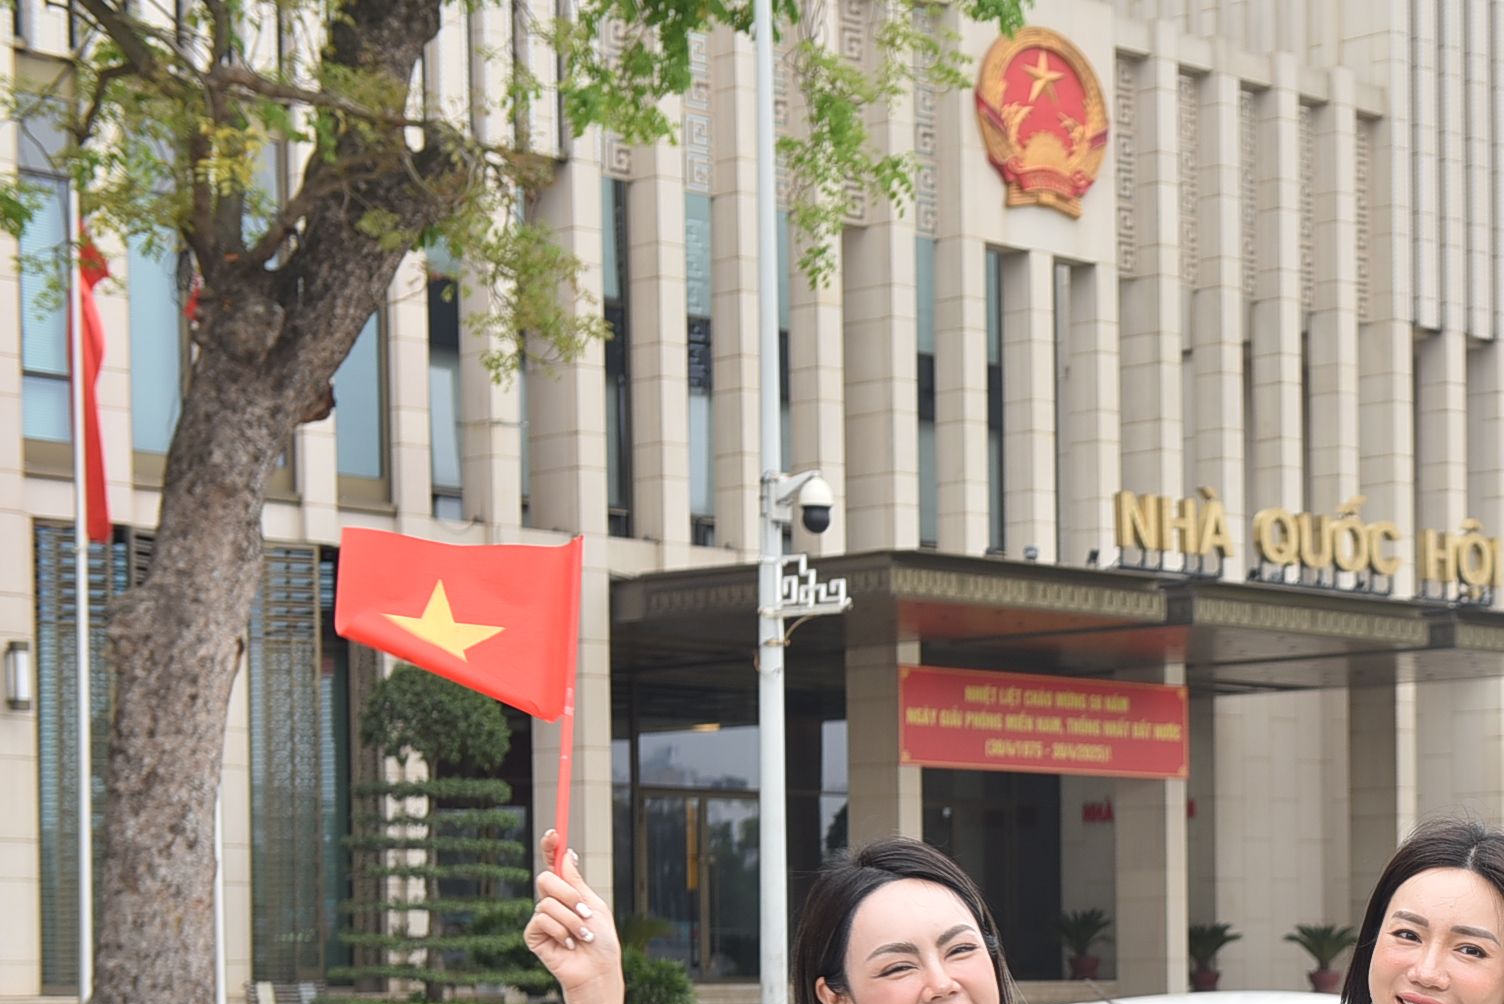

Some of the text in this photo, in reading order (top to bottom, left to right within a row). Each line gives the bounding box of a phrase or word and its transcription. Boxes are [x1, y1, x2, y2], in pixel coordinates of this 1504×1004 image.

[1114, 486, 1503, 600] NHÀ QUỐC HỘI
